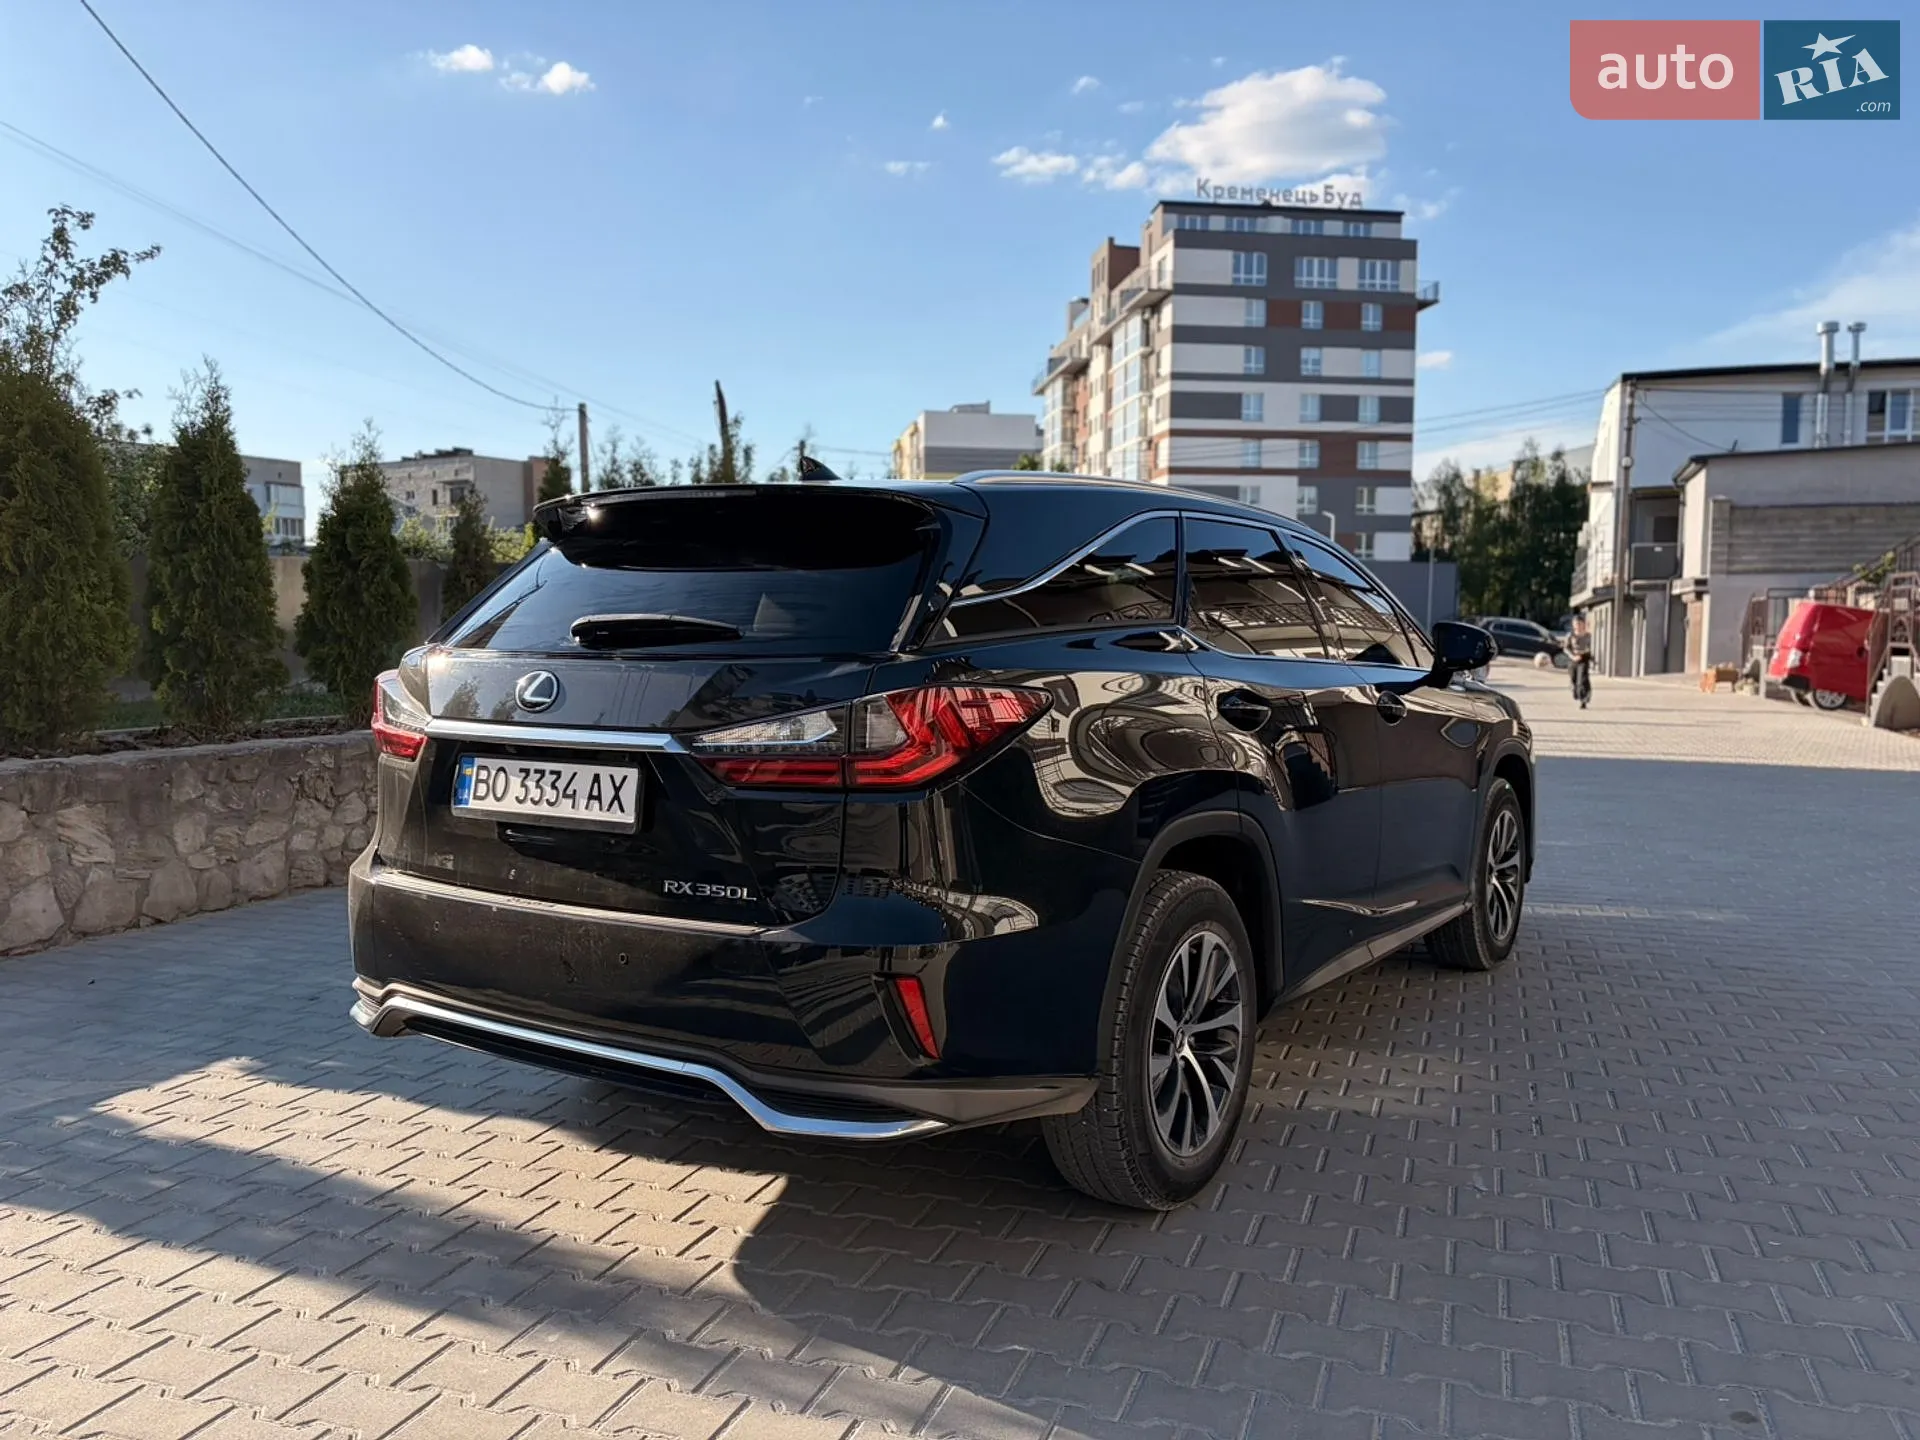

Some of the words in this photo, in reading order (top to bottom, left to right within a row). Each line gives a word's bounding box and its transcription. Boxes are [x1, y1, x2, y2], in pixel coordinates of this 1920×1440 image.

[473, 765, 508, 802] BO
[515, 767, 578, 810] 3334
[584, 772, 629, 813] AX
